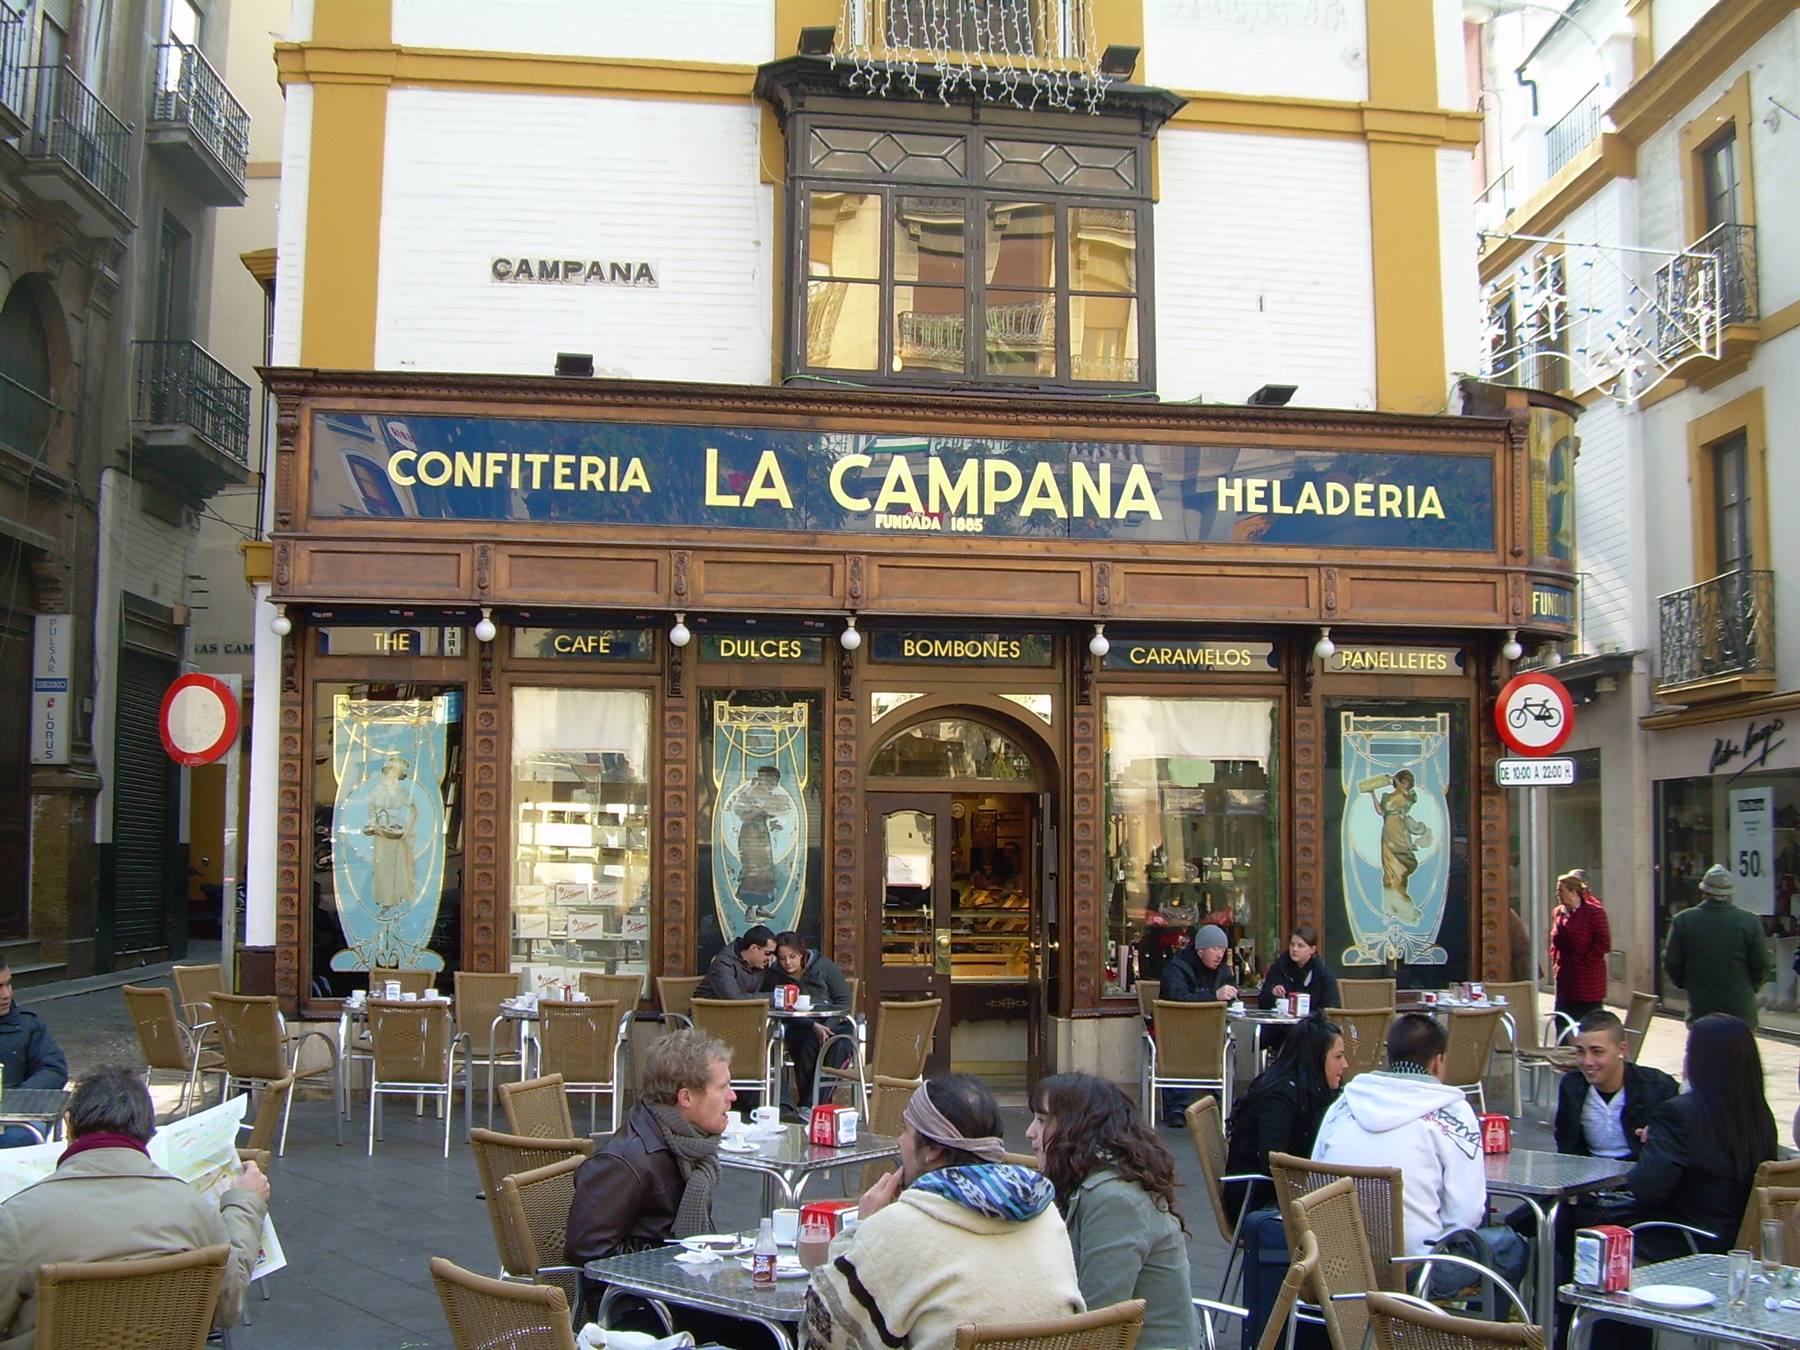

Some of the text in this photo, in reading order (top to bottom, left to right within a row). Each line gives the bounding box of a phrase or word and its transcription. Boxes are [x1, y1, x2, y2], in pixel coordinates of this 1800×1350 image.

[492, 258, 656, 285] CAMPANA
[387, 448, 1446, 520] CONFITERIA LA CAMPANA HELADERIA
[875, 514, 941, 530] FUNDADA
[48, 618, 57, 673] PULSAR
[373, 633, 410, 651] THE
[720, 639, 802, 658] DULCES
[903, 639, 1021, 659] BOMBONES
[1130, 647, 1251, 666] CARAMELOS
[1342, 651, 1447, 670] PANELLETES
[45, 712, 55, 758] LORUS
[1500, 767, 1510, 780] DE
[1535, 766, 1540, 778] A
